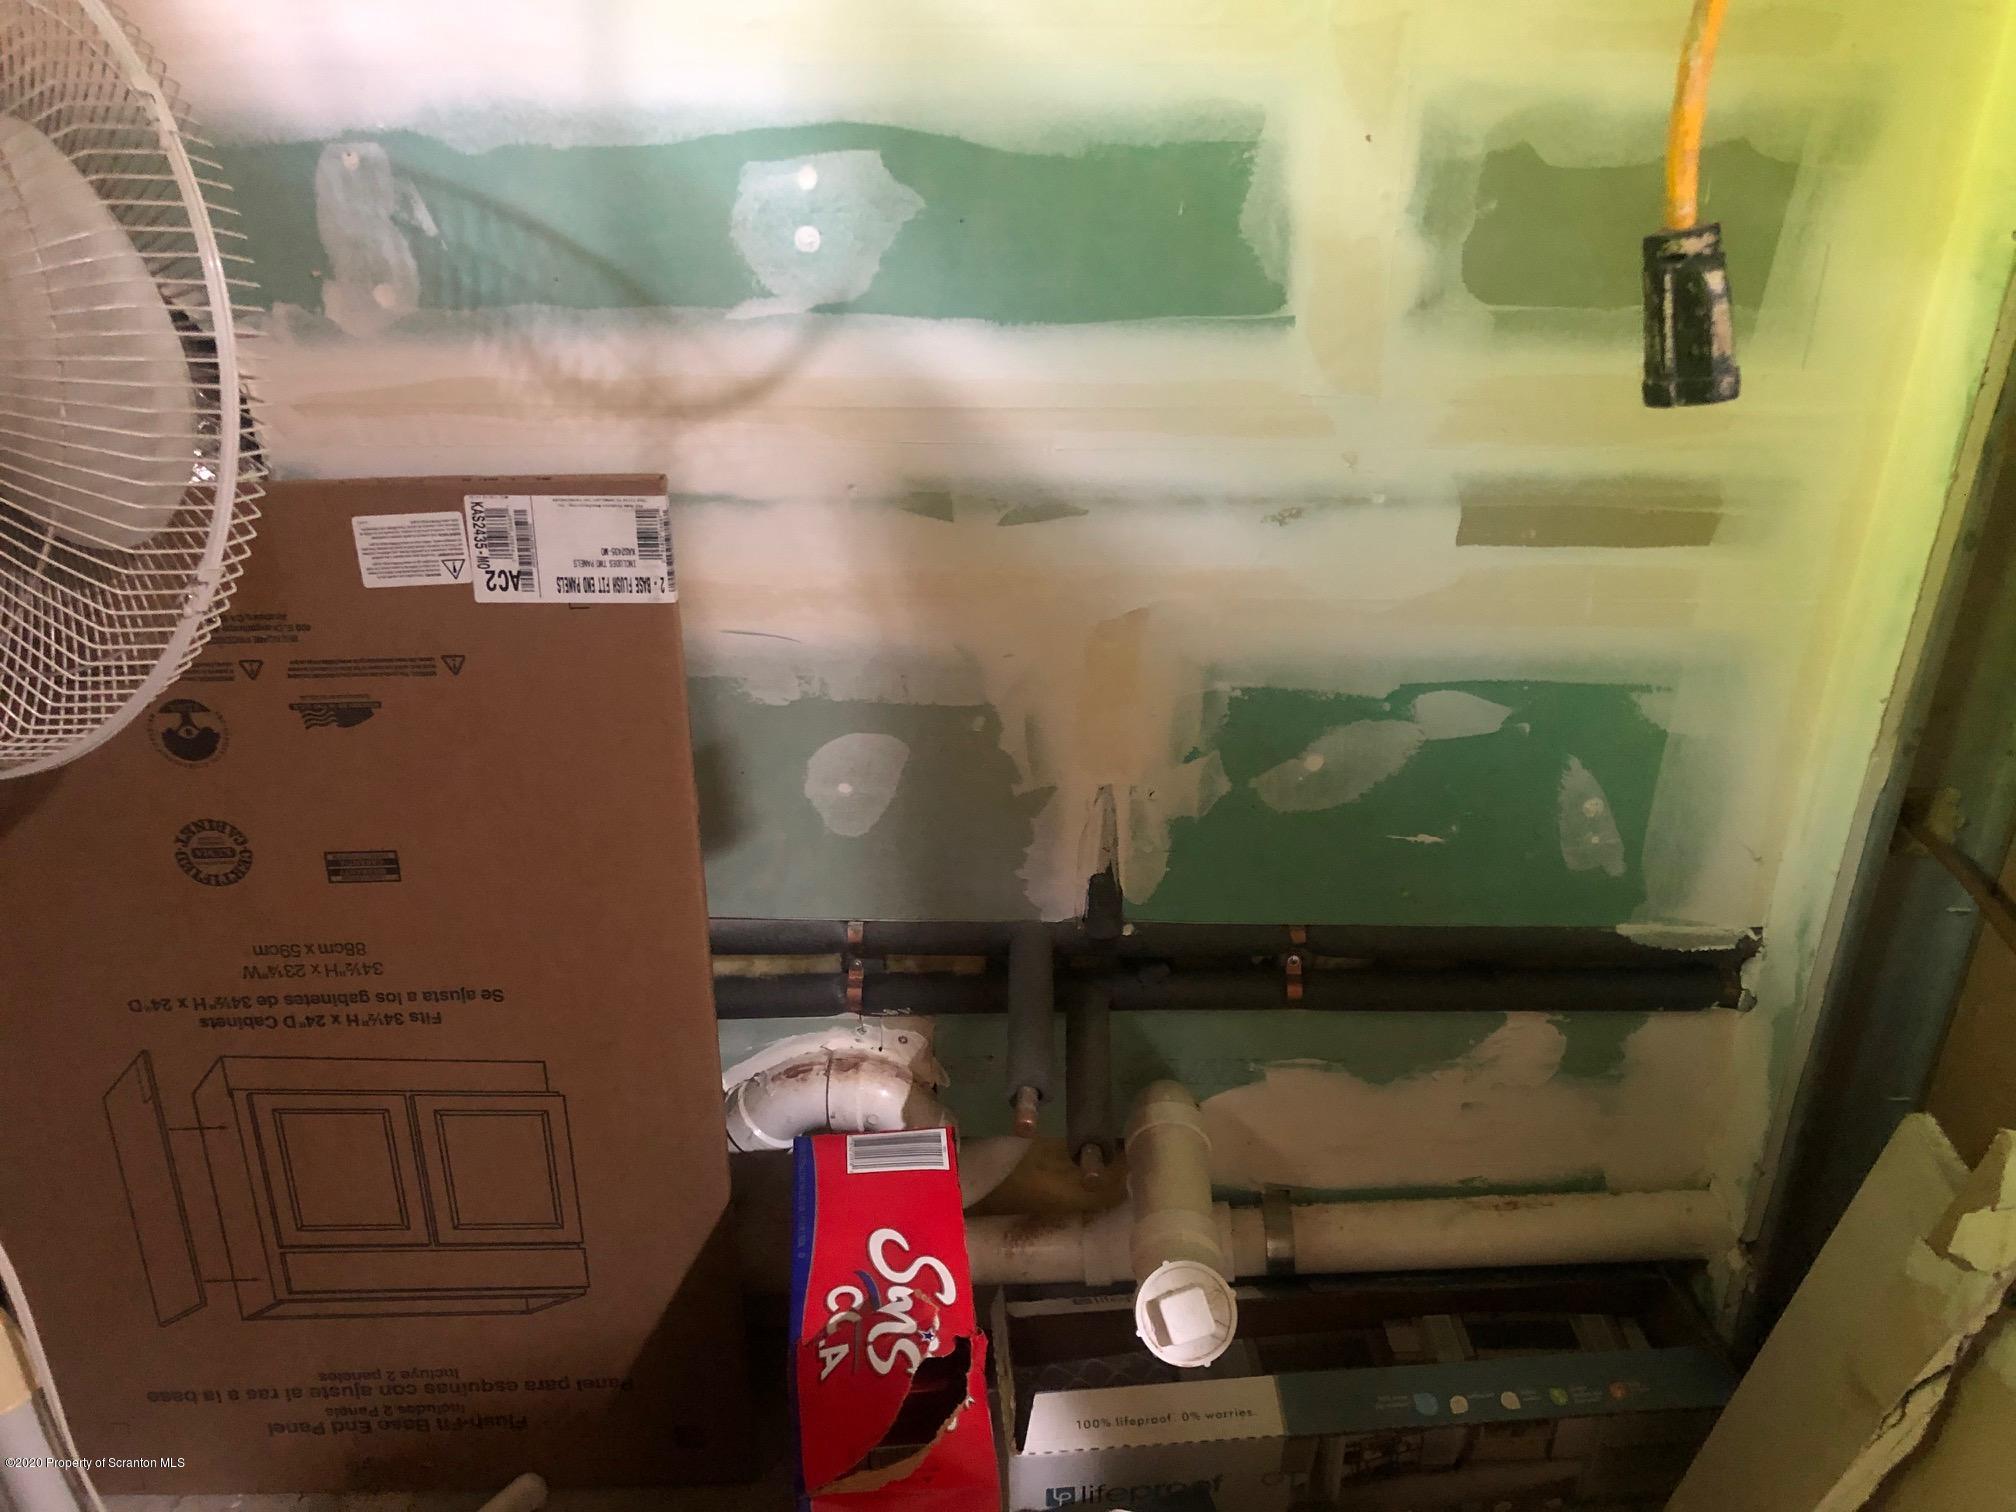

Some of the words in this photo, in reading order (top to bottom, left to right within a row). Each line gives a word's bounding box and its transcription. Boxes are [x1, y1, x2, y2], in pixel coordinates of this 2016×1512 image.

[471, 501, 489, 570] KAS2435-MO
[572, 560, 594, 568] PANELS
[484, 570, 522, 592] AC2
[556, 576, 581, 594] PANELS
[582, 577, 595, 594] END
[598, 577, 610, 594] FIT
[612, 576, 633, 594] FLUSH
[634, 576, 652, 594] BASE
[660, 576, 666, 594] 2
[252, 943, 302, 958] 59cm
[304, 943, 314, 954] x
[310, 963, 321, 975] x
[256, 994, 279, 1009] de
[283, 990, 371, 1008] gabinetes
[374, 992, 403, 1006] los
[406, 991, 418, 1002] a
[422, 986, 476, 1004] ajusta
[480, 988, 504, 1003] Se
[176, 997, 189, 1009] x
[198, 1015, 278, 1030] Cabinets
[330, 1013, 341, 1025] x
[408, 1011, 442, 1025] Fits
[317, 1368, 381, 1384] paneles
[385, 1370, 396, 1382] 2
[400, 1366, 459, 1382] Incluye
[310, 1382, 373, 1401] ajuste
[379, 1383, 416, 1397] con
[424, 1378, 518, 1397] esquinas
[524, 1376, 570, 1393] para
[576, 1377, 634, 1392] Panel
[146, 1390, 198, 1404] base
[202, 1390, 222, 1404] la
[226, 1388, 240, 1402] a
[246, 1387, 280, 1402] ras
[284, 1388, 304, 1402] al
[324, 1406, 379, 1419] Panels
[384, 1405, 393, 1417] 2
[398, 1403, 465, 1414] Includes
[377, 1418, 431, 1432] Base
[436, 1414, 528, 1432] Flush-Fit
[1076, 1418, 1112, 1430] 100%
[1181, 1412, 1200, 1423] 0%
[1204, 1408, 1258, 1420] worries.
[267, 1421, 325, 1437] Panel
[331, 1420, 372, 1434] End
